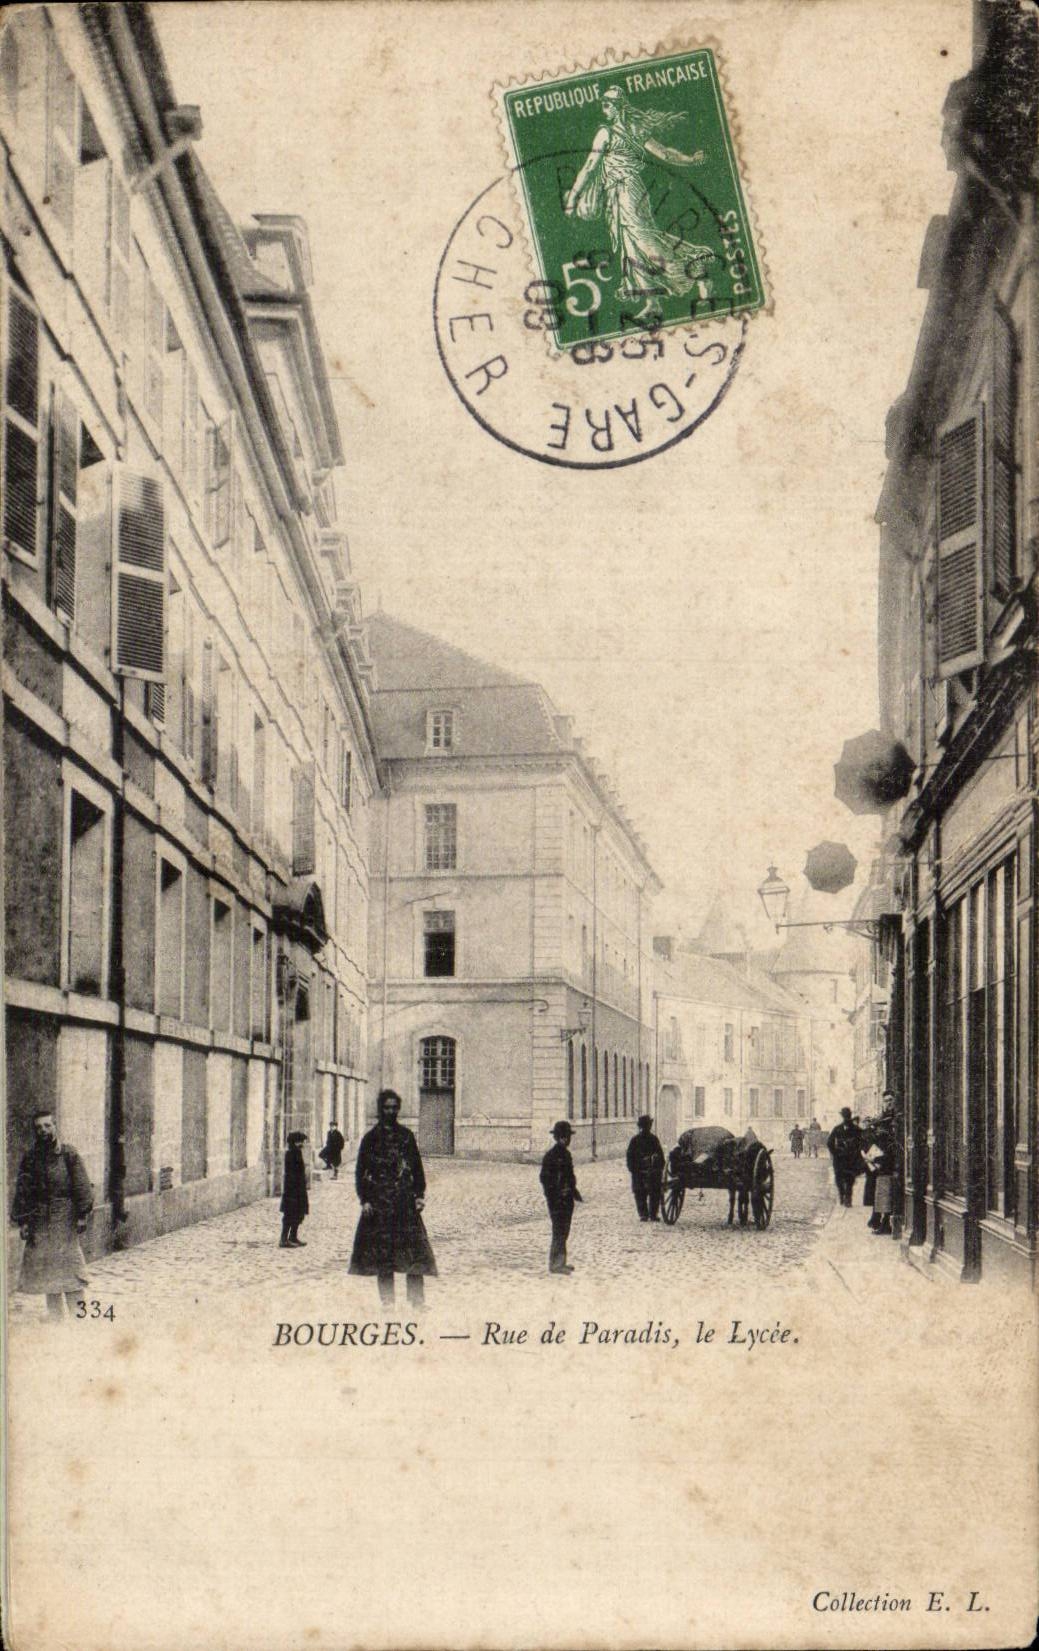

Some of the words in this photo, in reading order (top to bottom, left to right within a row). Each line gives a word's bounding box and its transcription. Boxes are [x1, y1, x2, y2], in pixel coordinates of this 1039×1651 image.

[513, 83, 601, 119] REPUBLIQUE
[625, 60, 708, 95] FRANÇAISE
[722, 210, 751, 295] POSTES
[449, 214, 514, 396] CHER
